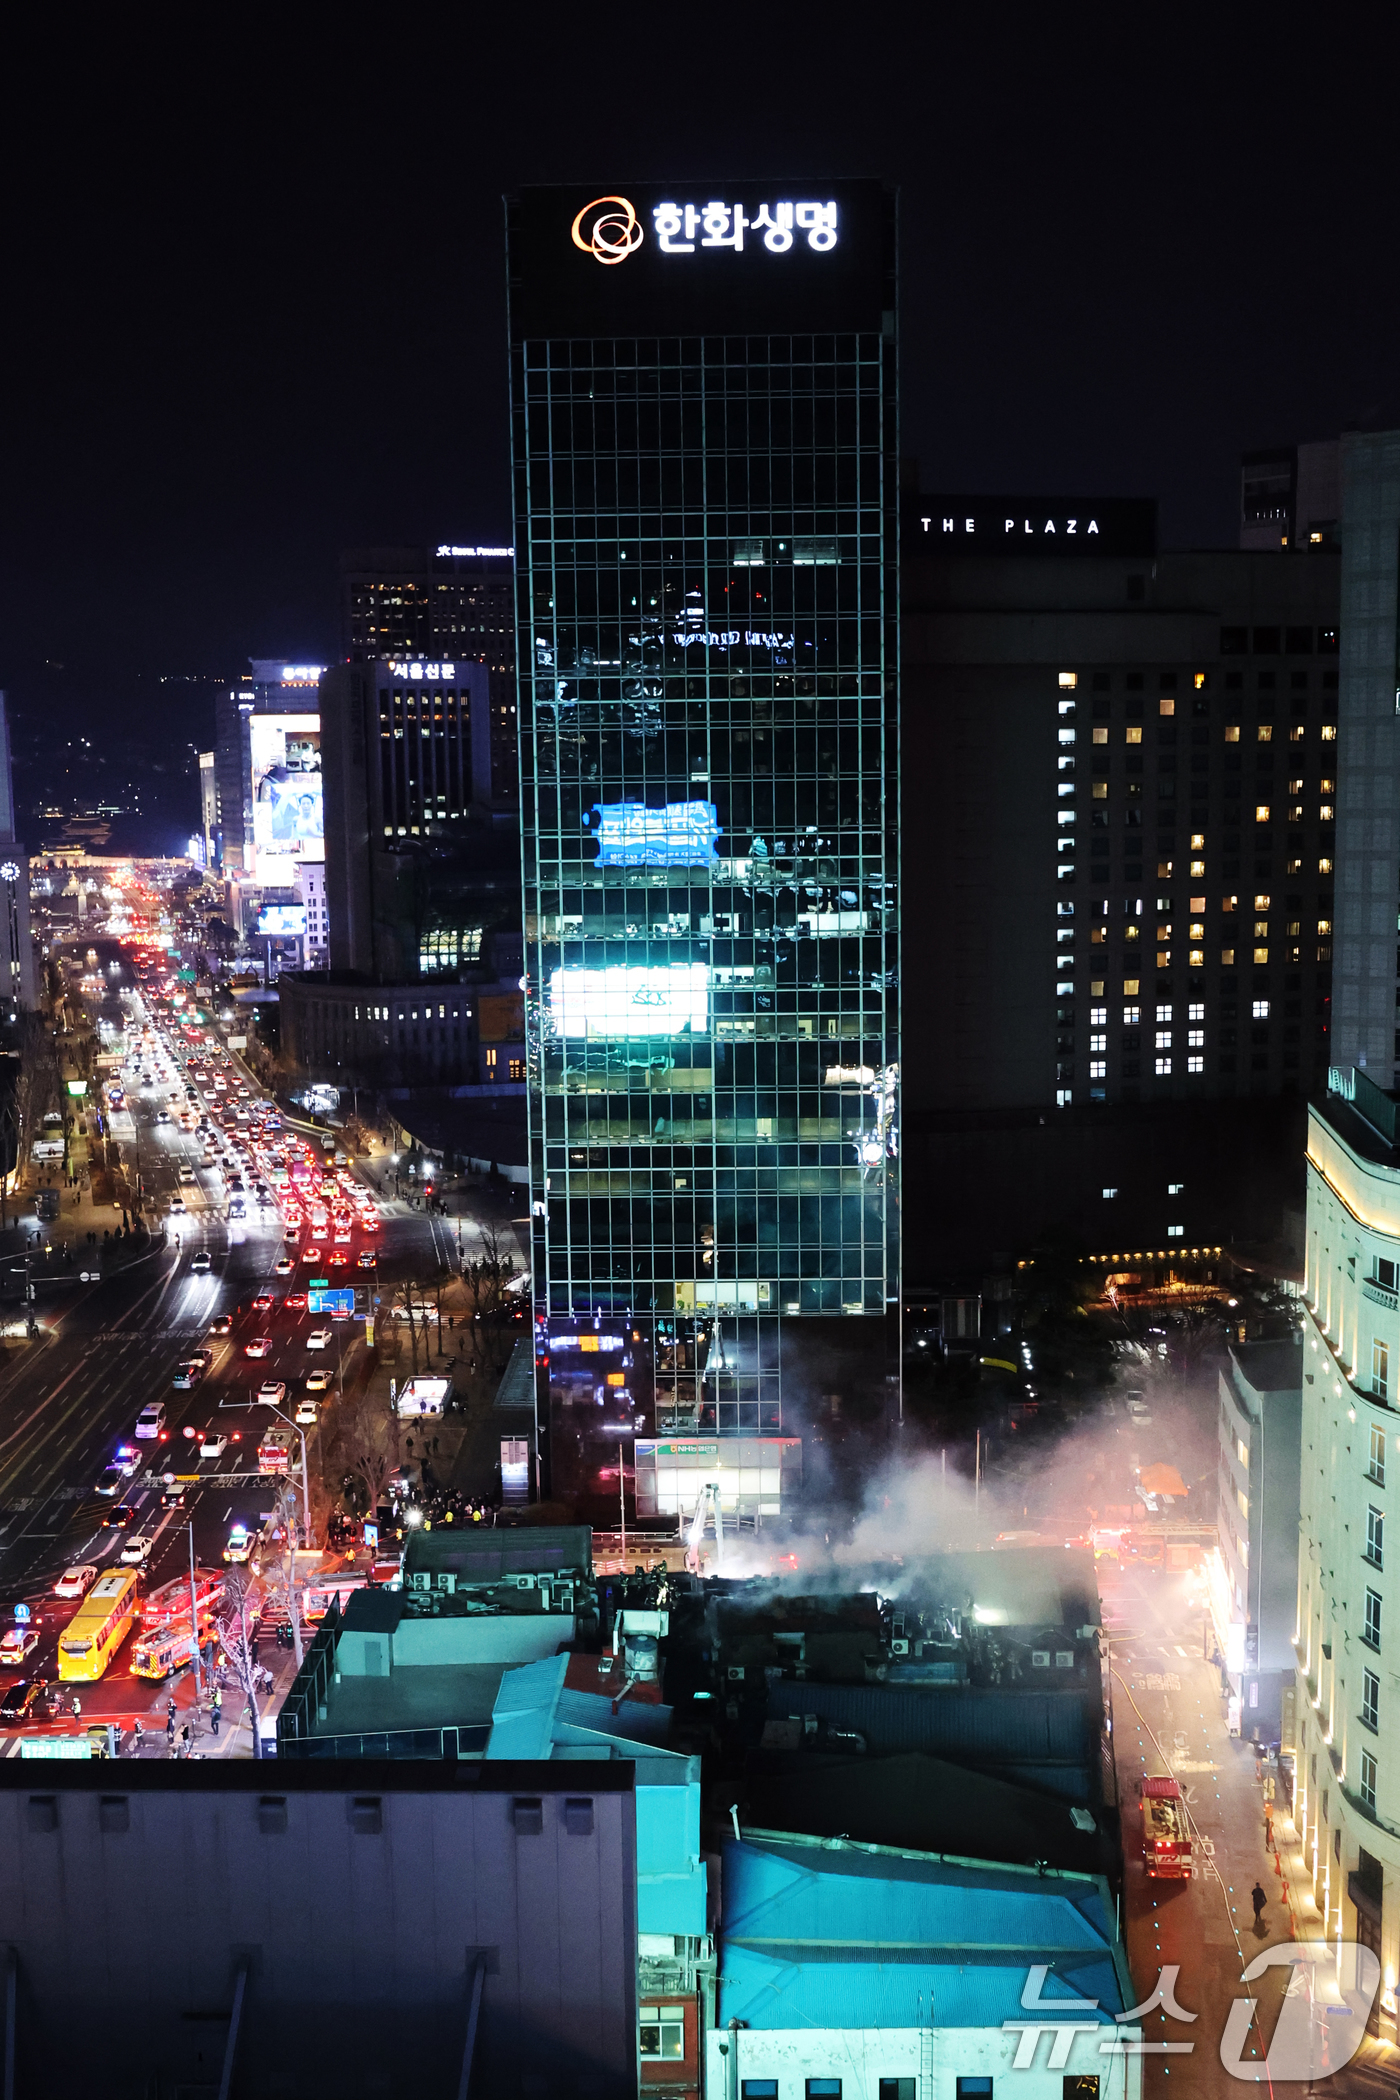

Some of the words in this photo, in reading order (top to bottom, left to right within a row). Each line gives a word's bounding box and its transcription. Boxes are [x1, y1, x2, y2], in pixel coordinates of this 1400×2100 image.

[653, 202, 838, 253] 한화생명
[921, 518, 975, 533] THE
[1005, 519, 1100, 534] PLAZA
[393, 662, 456, 680] 서울신문
